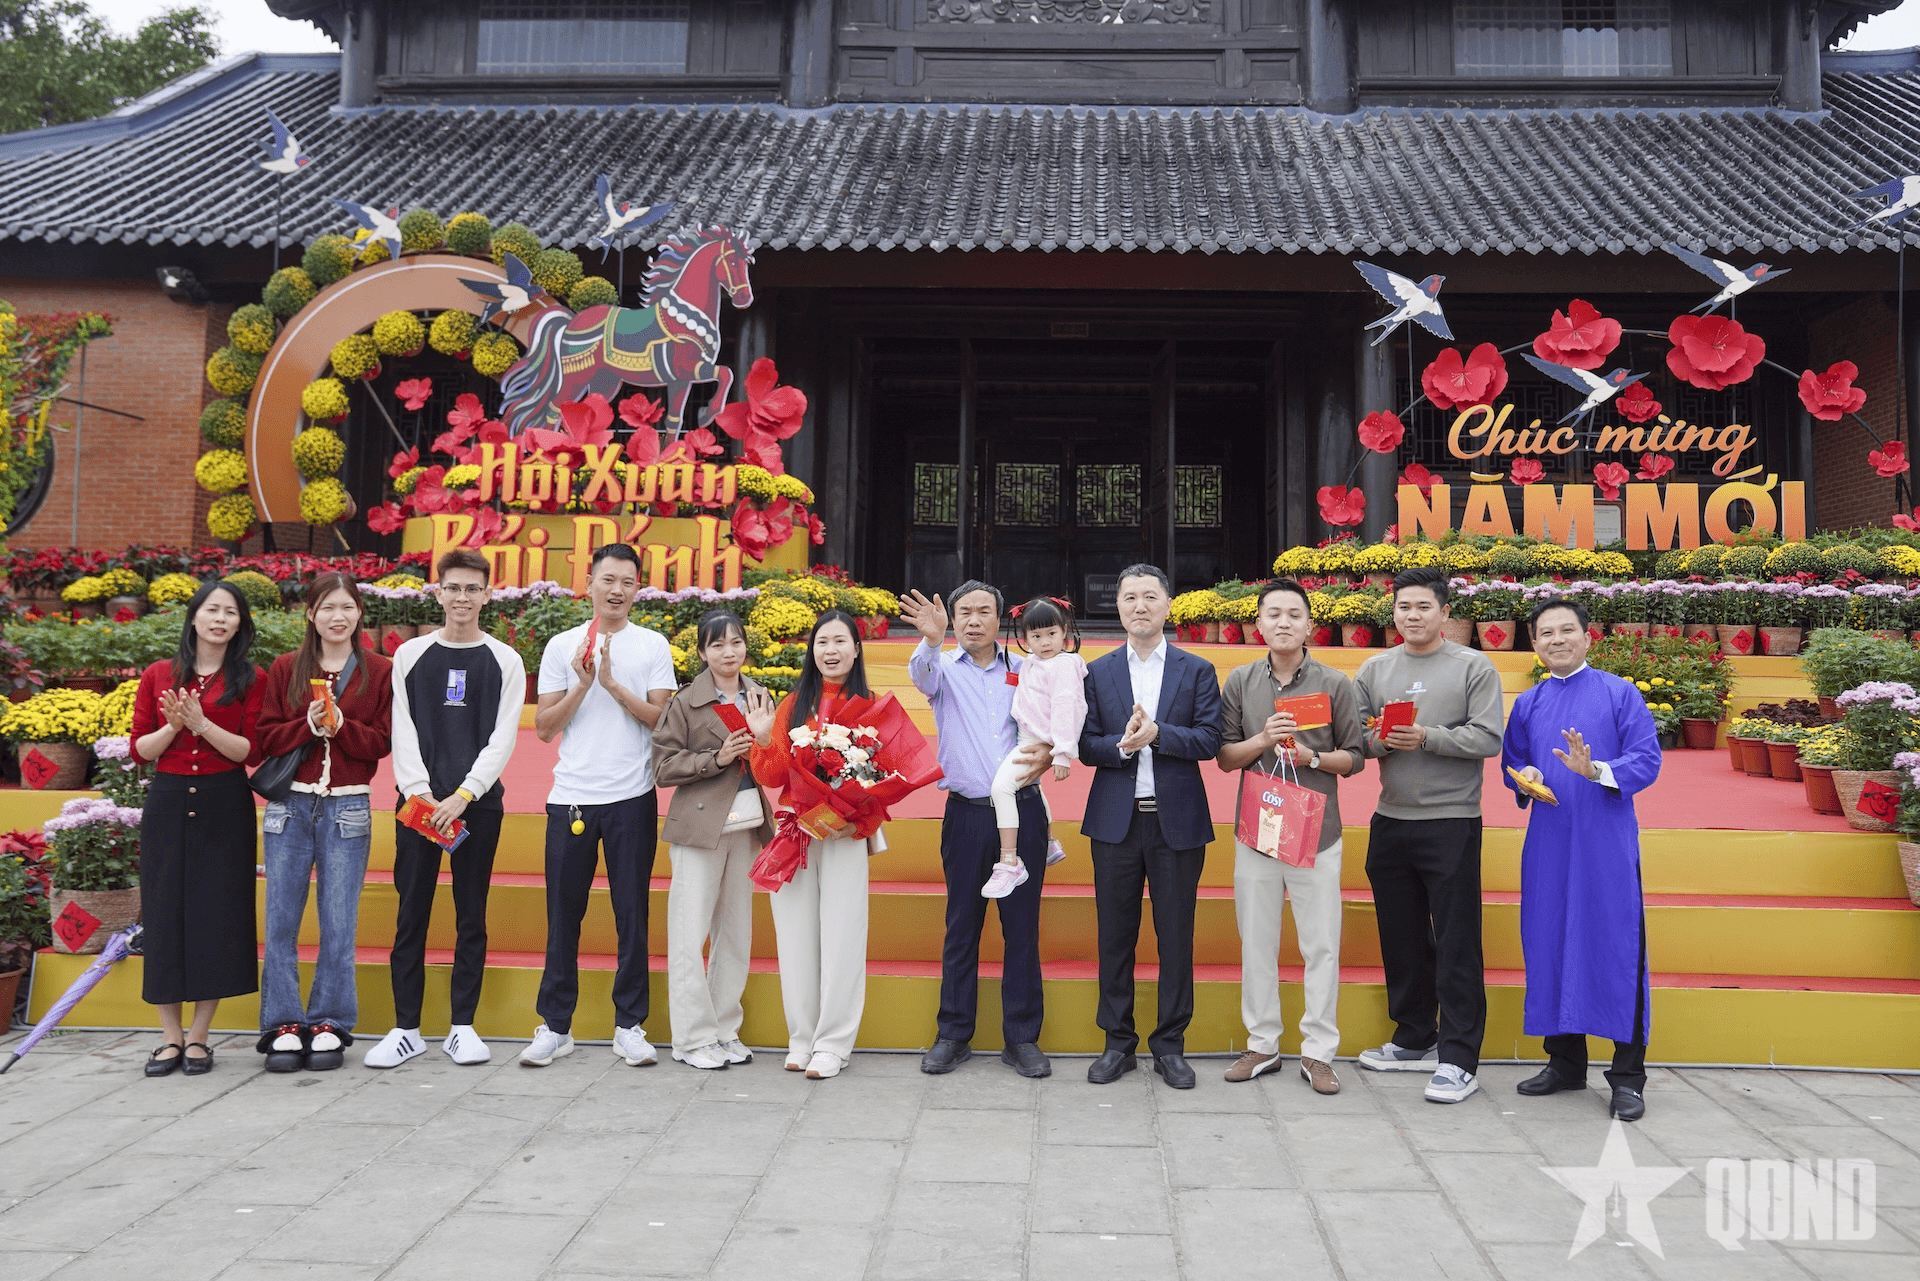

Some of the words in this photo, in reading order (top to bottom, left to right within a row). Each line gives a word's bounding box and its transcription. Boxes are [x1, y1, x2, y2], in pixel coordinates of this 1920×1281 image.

[1448, 403, 1579, 459] Chúc
[1596, 413, 1758, 477] mừng
[480, 442, 571, 510] Hội
[580, 443, 740, 504] Xuân
[1397, 471, 1596, 551] NĂM
[1625, 463, 1806, 551] MỚI
[1262, 790, 1285, 808] COSY
